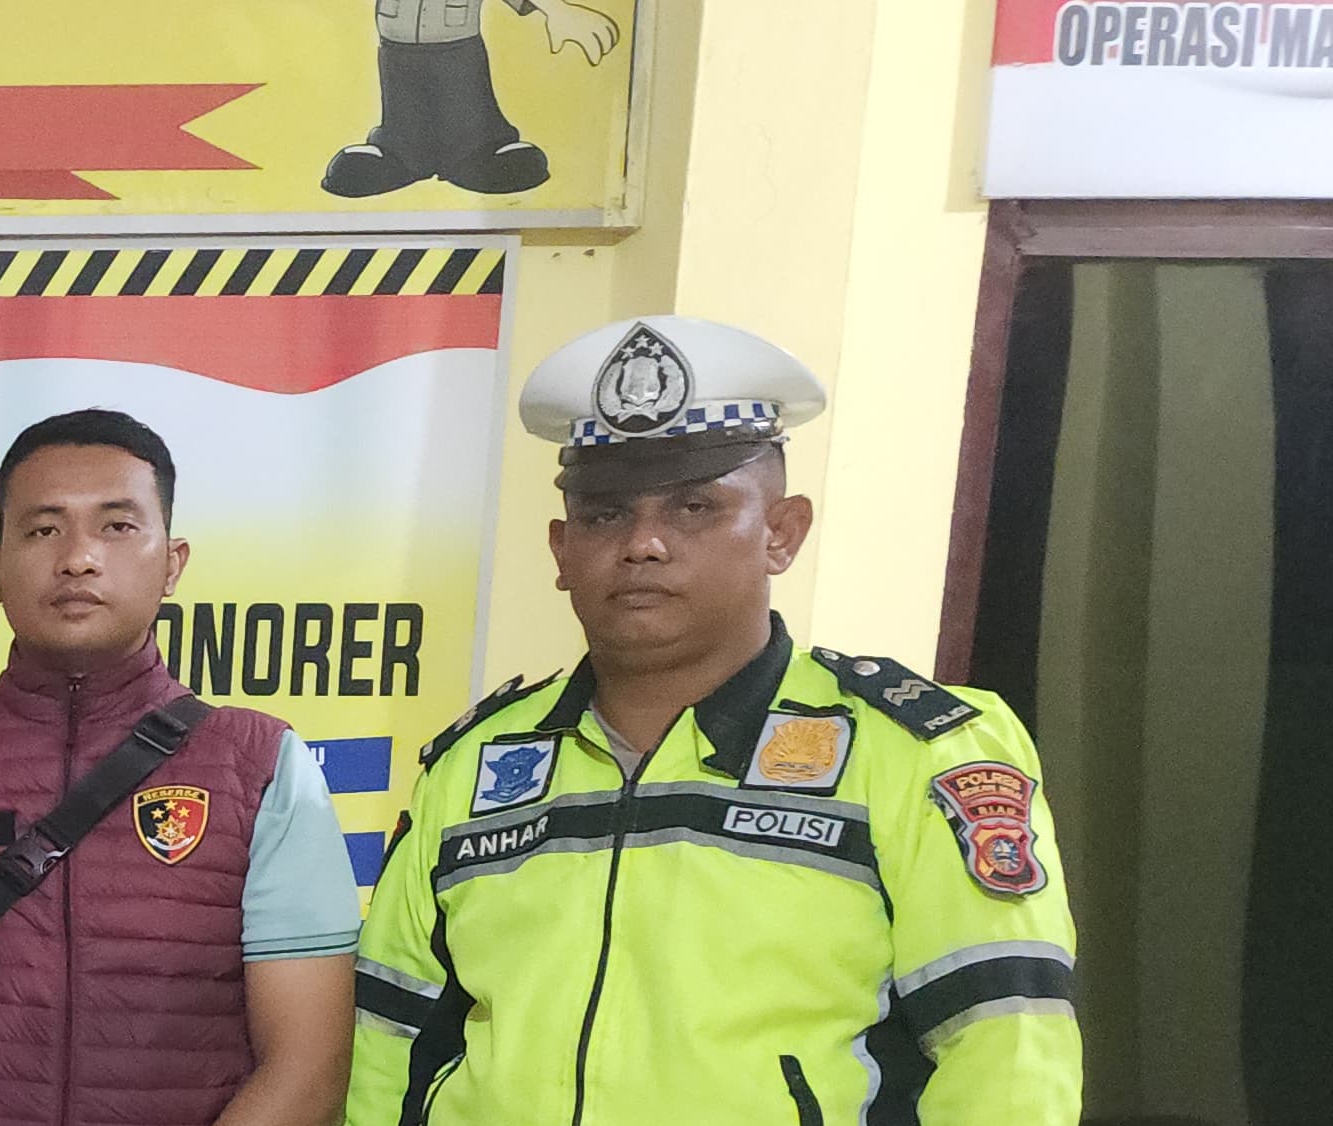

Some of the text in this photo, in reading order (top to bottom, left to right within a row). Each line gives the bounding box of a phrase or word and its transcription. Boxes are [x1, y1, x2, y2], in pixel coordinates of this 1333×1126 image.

[1058, 5, 1333, 67] OPERASI MA
[155, 602, 424, 697] ONORER
[456, 815, 549, 861] ANHAR
[731, 809, 836, 843] POLISI
